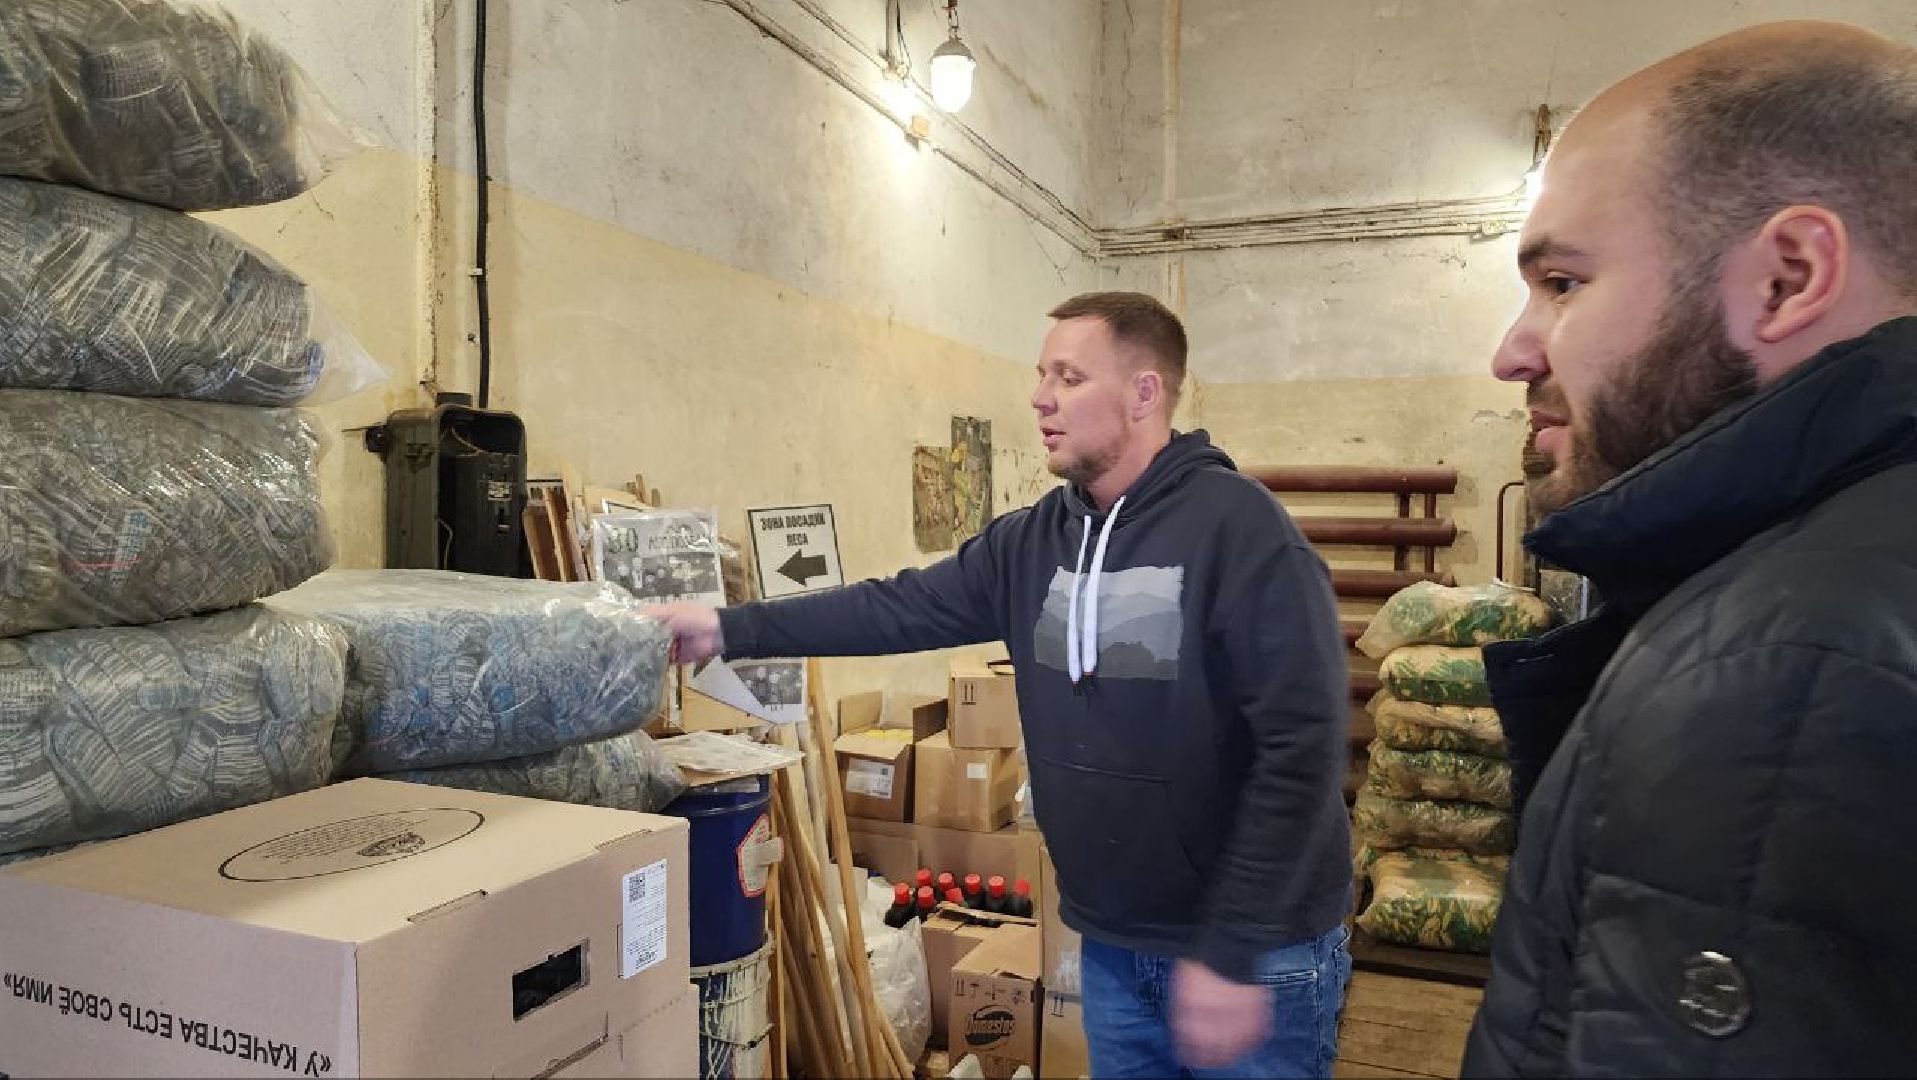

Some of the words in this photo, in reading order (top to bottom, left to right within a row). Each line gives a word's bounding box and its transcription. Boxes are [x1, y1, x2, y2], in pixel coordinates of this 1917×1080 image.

[760, 516, 784, 531] ЗОНА
[786, 533, 808, 546] ЛЕСА
[4, 973, 52, 1005] ИМЯ»
[59, 986, 112, 1021] СВОЁ
[119, 1003, 172, 1038] ЕСТЬ
[179, 1018, 297, 1071] КАЧЕСТВА
[305, 1051, 332, 1077] «У
